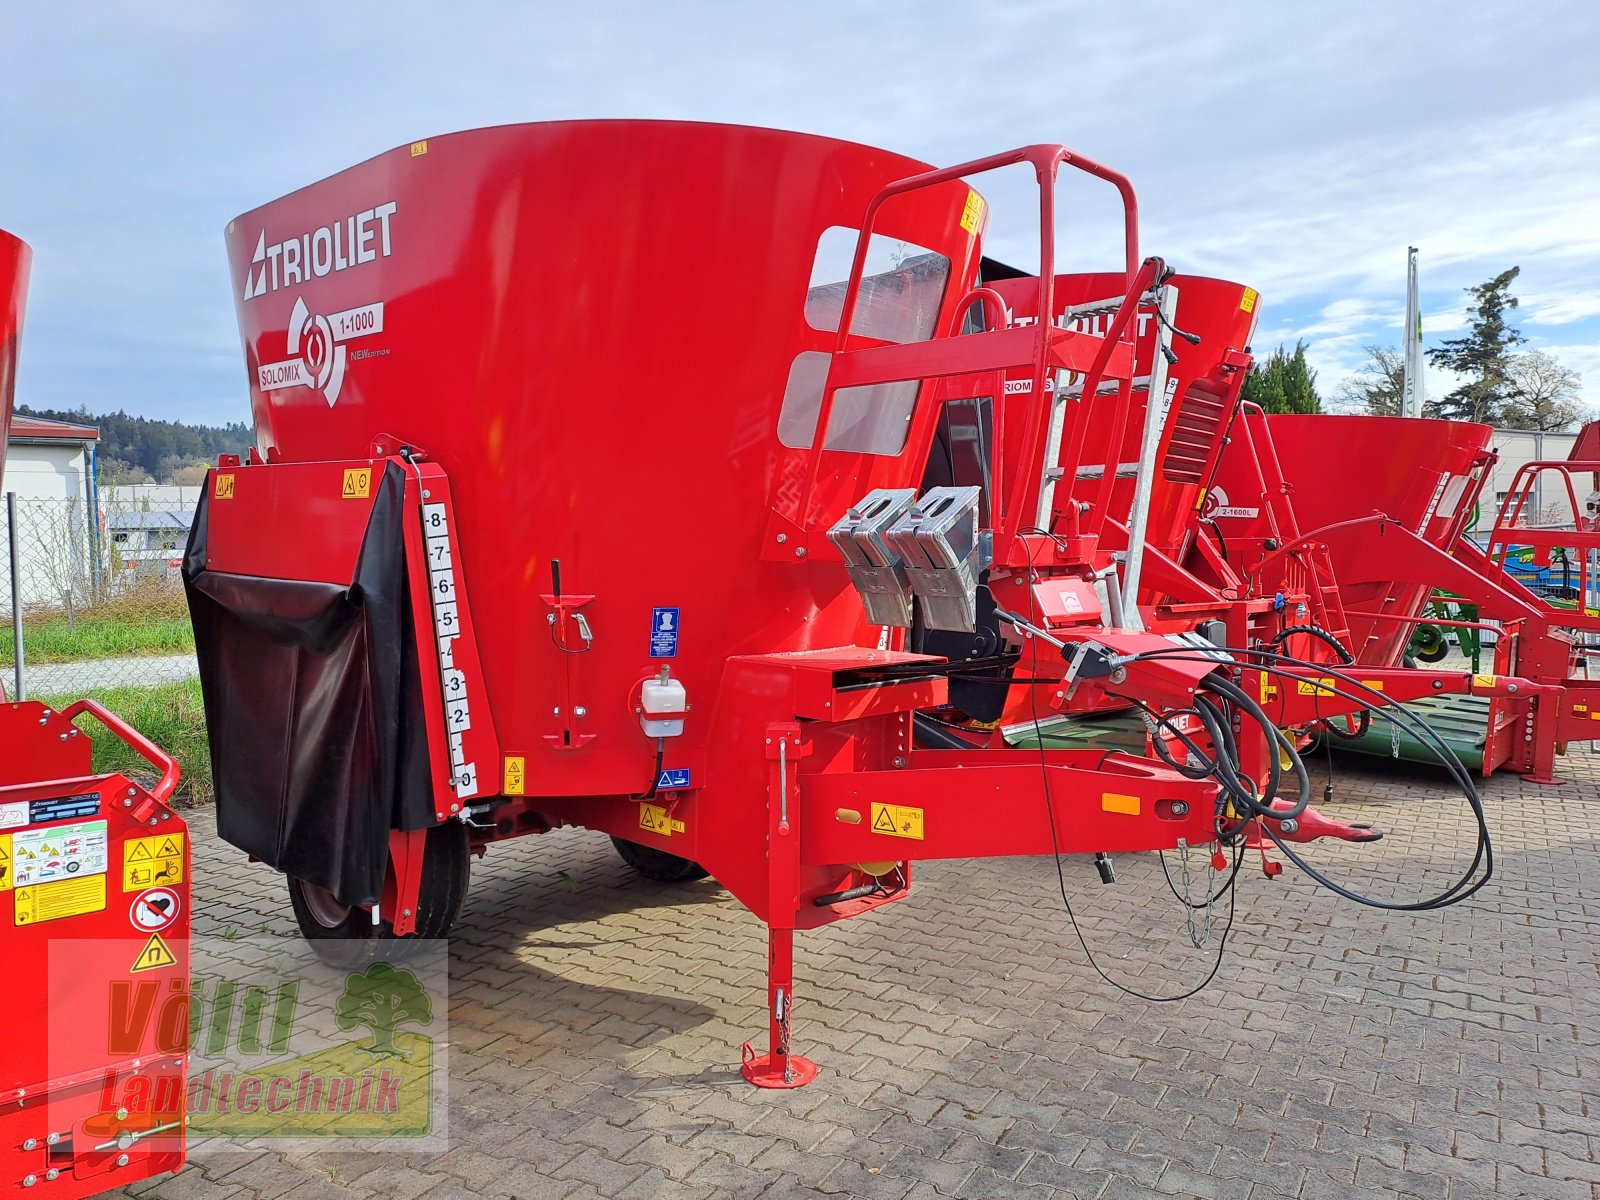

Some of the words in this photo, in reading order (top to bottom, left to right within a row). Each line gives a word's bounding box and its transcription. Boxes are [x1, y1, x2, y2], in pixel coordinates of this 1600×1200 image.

[267, 201, 397, 291] TRIOLIET
[339, 310, 375, 335] 1-1000
[261, 363, 301, 386] SOLOMIX
[430, 513, 441, 527] 8
[434, 546, 445, 560] 7
[438, 579, 449, 593] 6
[442, 612, 453, 626] 5
[450, 677, 460, 692] 3
[454, 709, 464, 724] 2
